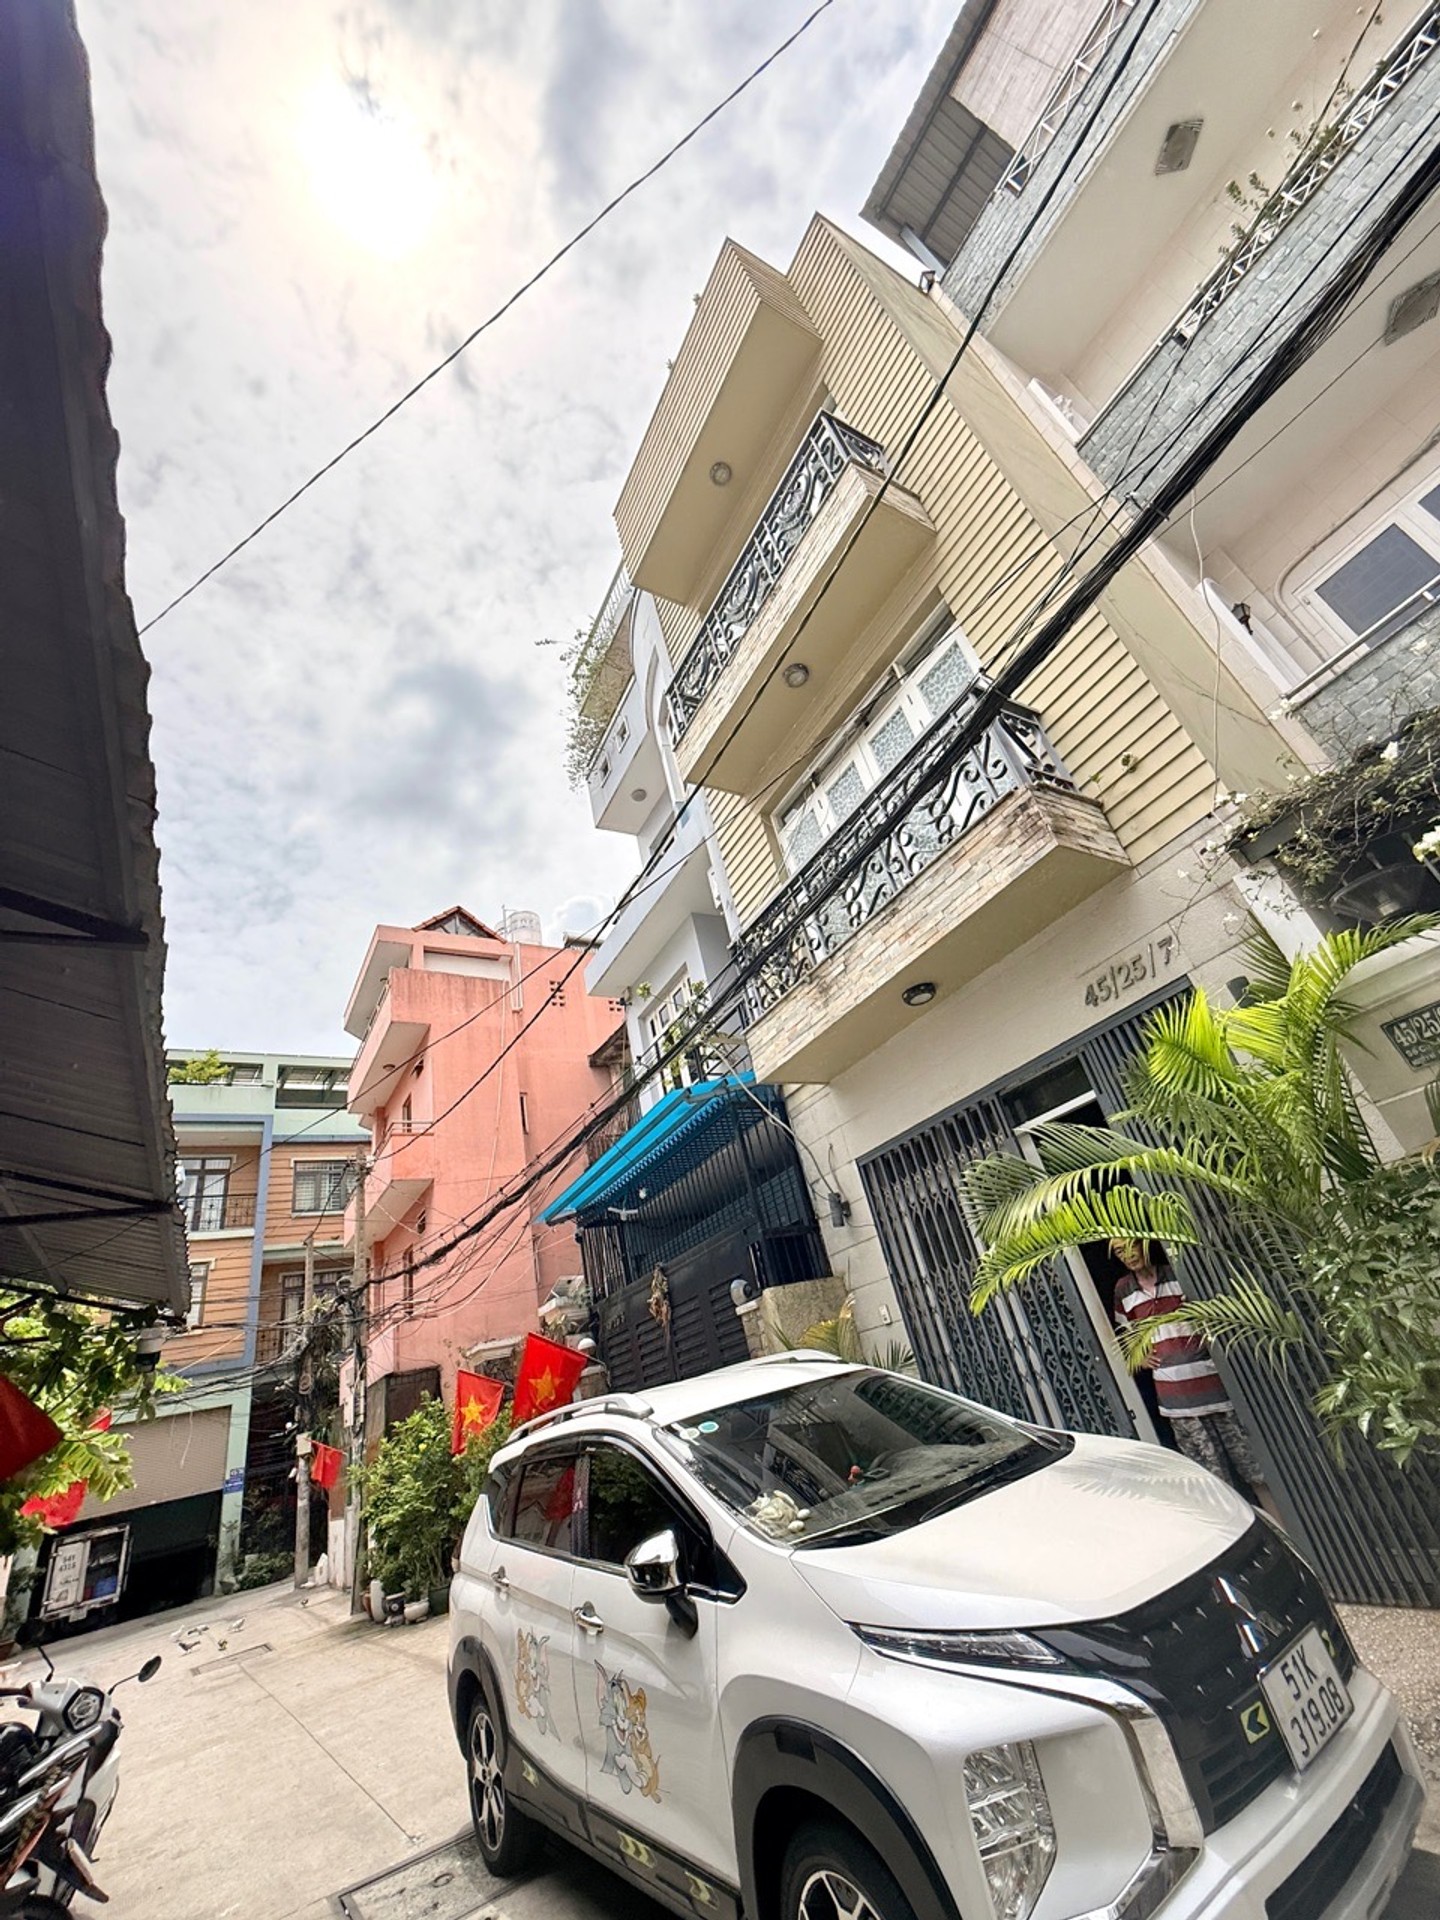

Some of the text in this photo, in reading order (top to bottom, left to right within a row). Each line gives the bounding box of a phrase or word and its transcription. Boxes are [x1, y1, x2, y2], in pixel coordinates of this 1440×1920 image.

[1084, 935, 1174, 1007] 45/25/7
[1280, 1644, 1318, 1701] 51K
[1291, 1676, 1345, 1758] 319.08
